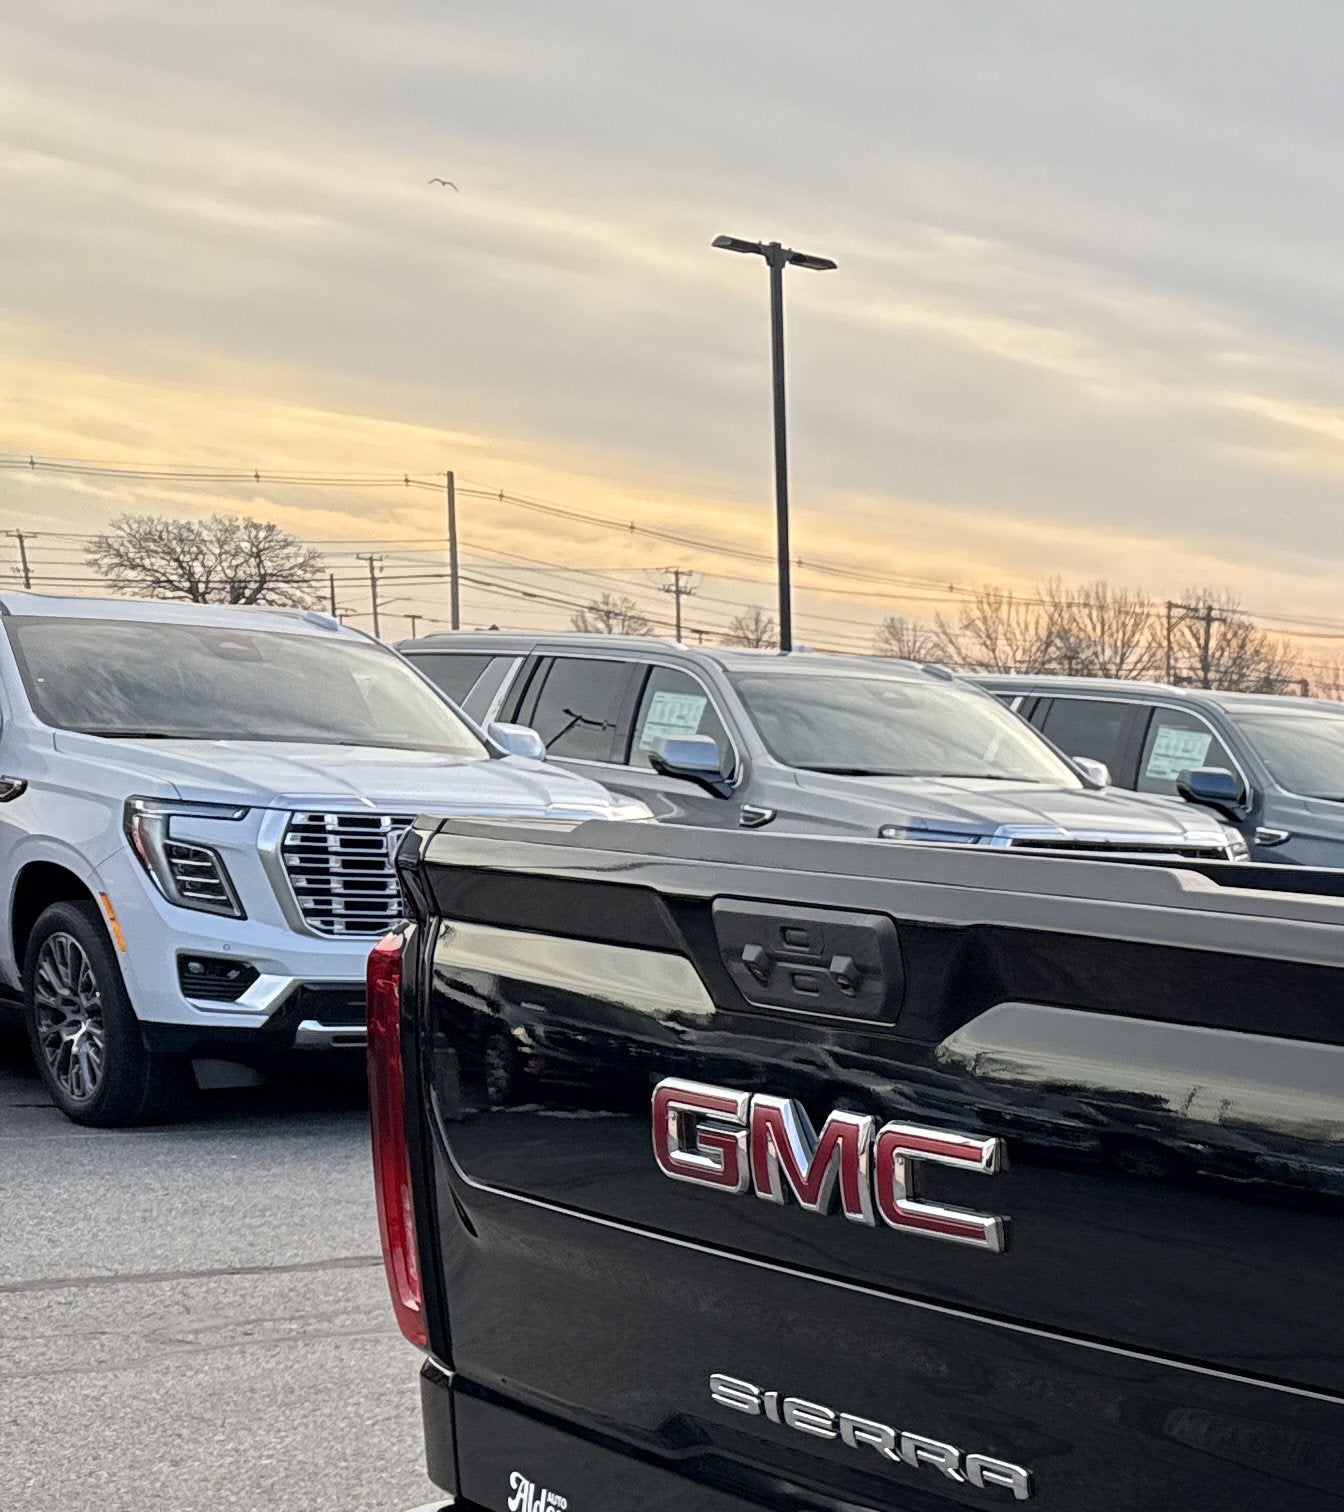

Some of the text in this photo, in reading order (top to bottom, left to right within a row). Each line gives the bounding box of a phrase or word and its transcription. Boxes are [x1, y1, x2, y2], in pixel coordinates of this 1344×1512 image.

[651, 1077, 1008, 1253] GMC
[709, 1373, 1034, 1500] SIERRA
[547, 1491, 568, 1510] AUTO
